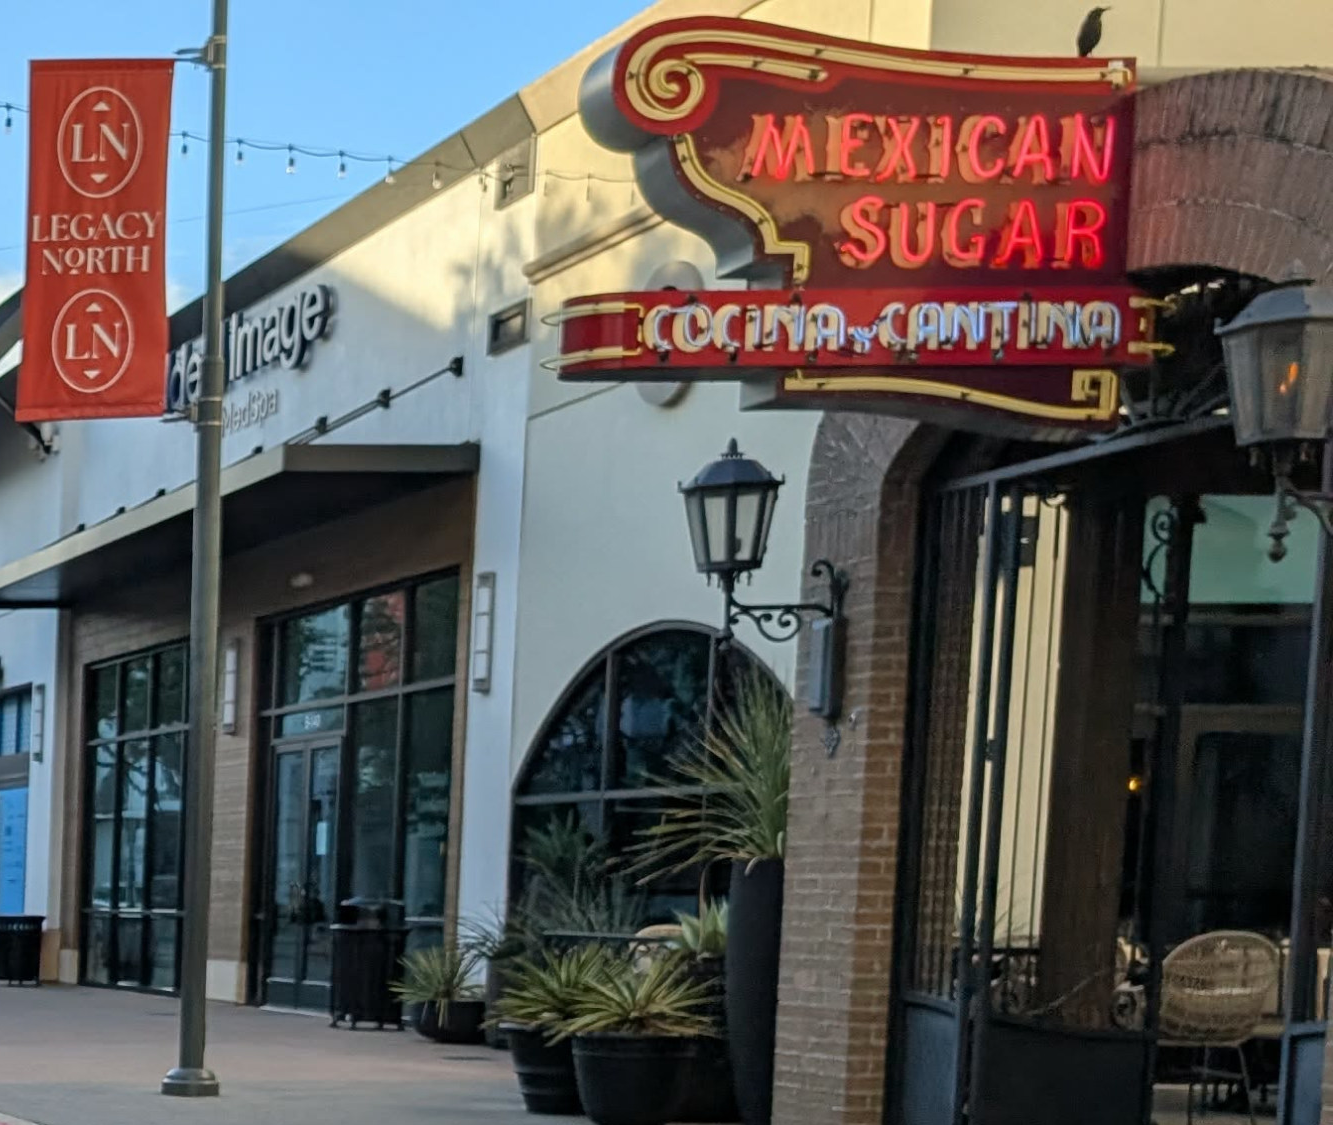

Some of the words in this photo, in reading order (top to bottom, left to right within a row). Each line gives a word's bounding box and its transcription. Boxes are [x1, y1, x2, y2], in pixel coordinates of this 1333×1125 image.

[70, 122, 131, 162] LN
[737, 112, 1115, 185] MEXICAN
[31, 211, 162, 243] LEGACY
[837, 196, 1107, 269] SUGAR
[41, 245, 151, 276] NORTH
[64, 321, 123, 361] LN
[228, 284, 331, 382] Image
[643, 303, 846, 353] COCINA
[878, 302, 1122, 352] CANTINA
